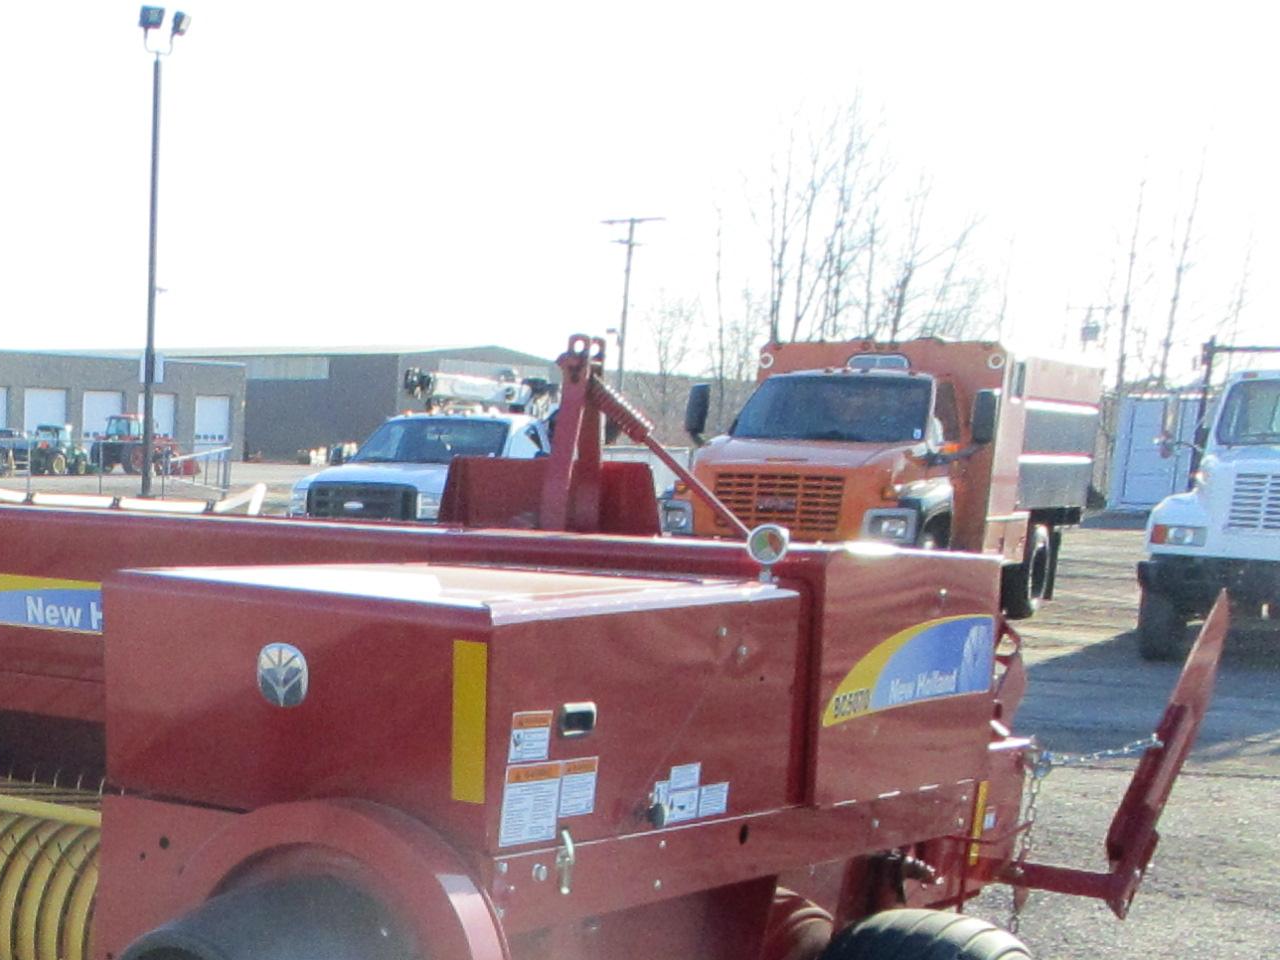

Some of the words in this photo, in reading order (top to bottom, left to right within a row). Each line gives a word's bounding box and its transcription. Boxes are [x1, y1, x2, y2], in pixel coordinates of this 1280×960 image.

[25, 595, 81, 627] New
[889, 676, 915, 704] New
[915, 669, 958, 697] Holland
